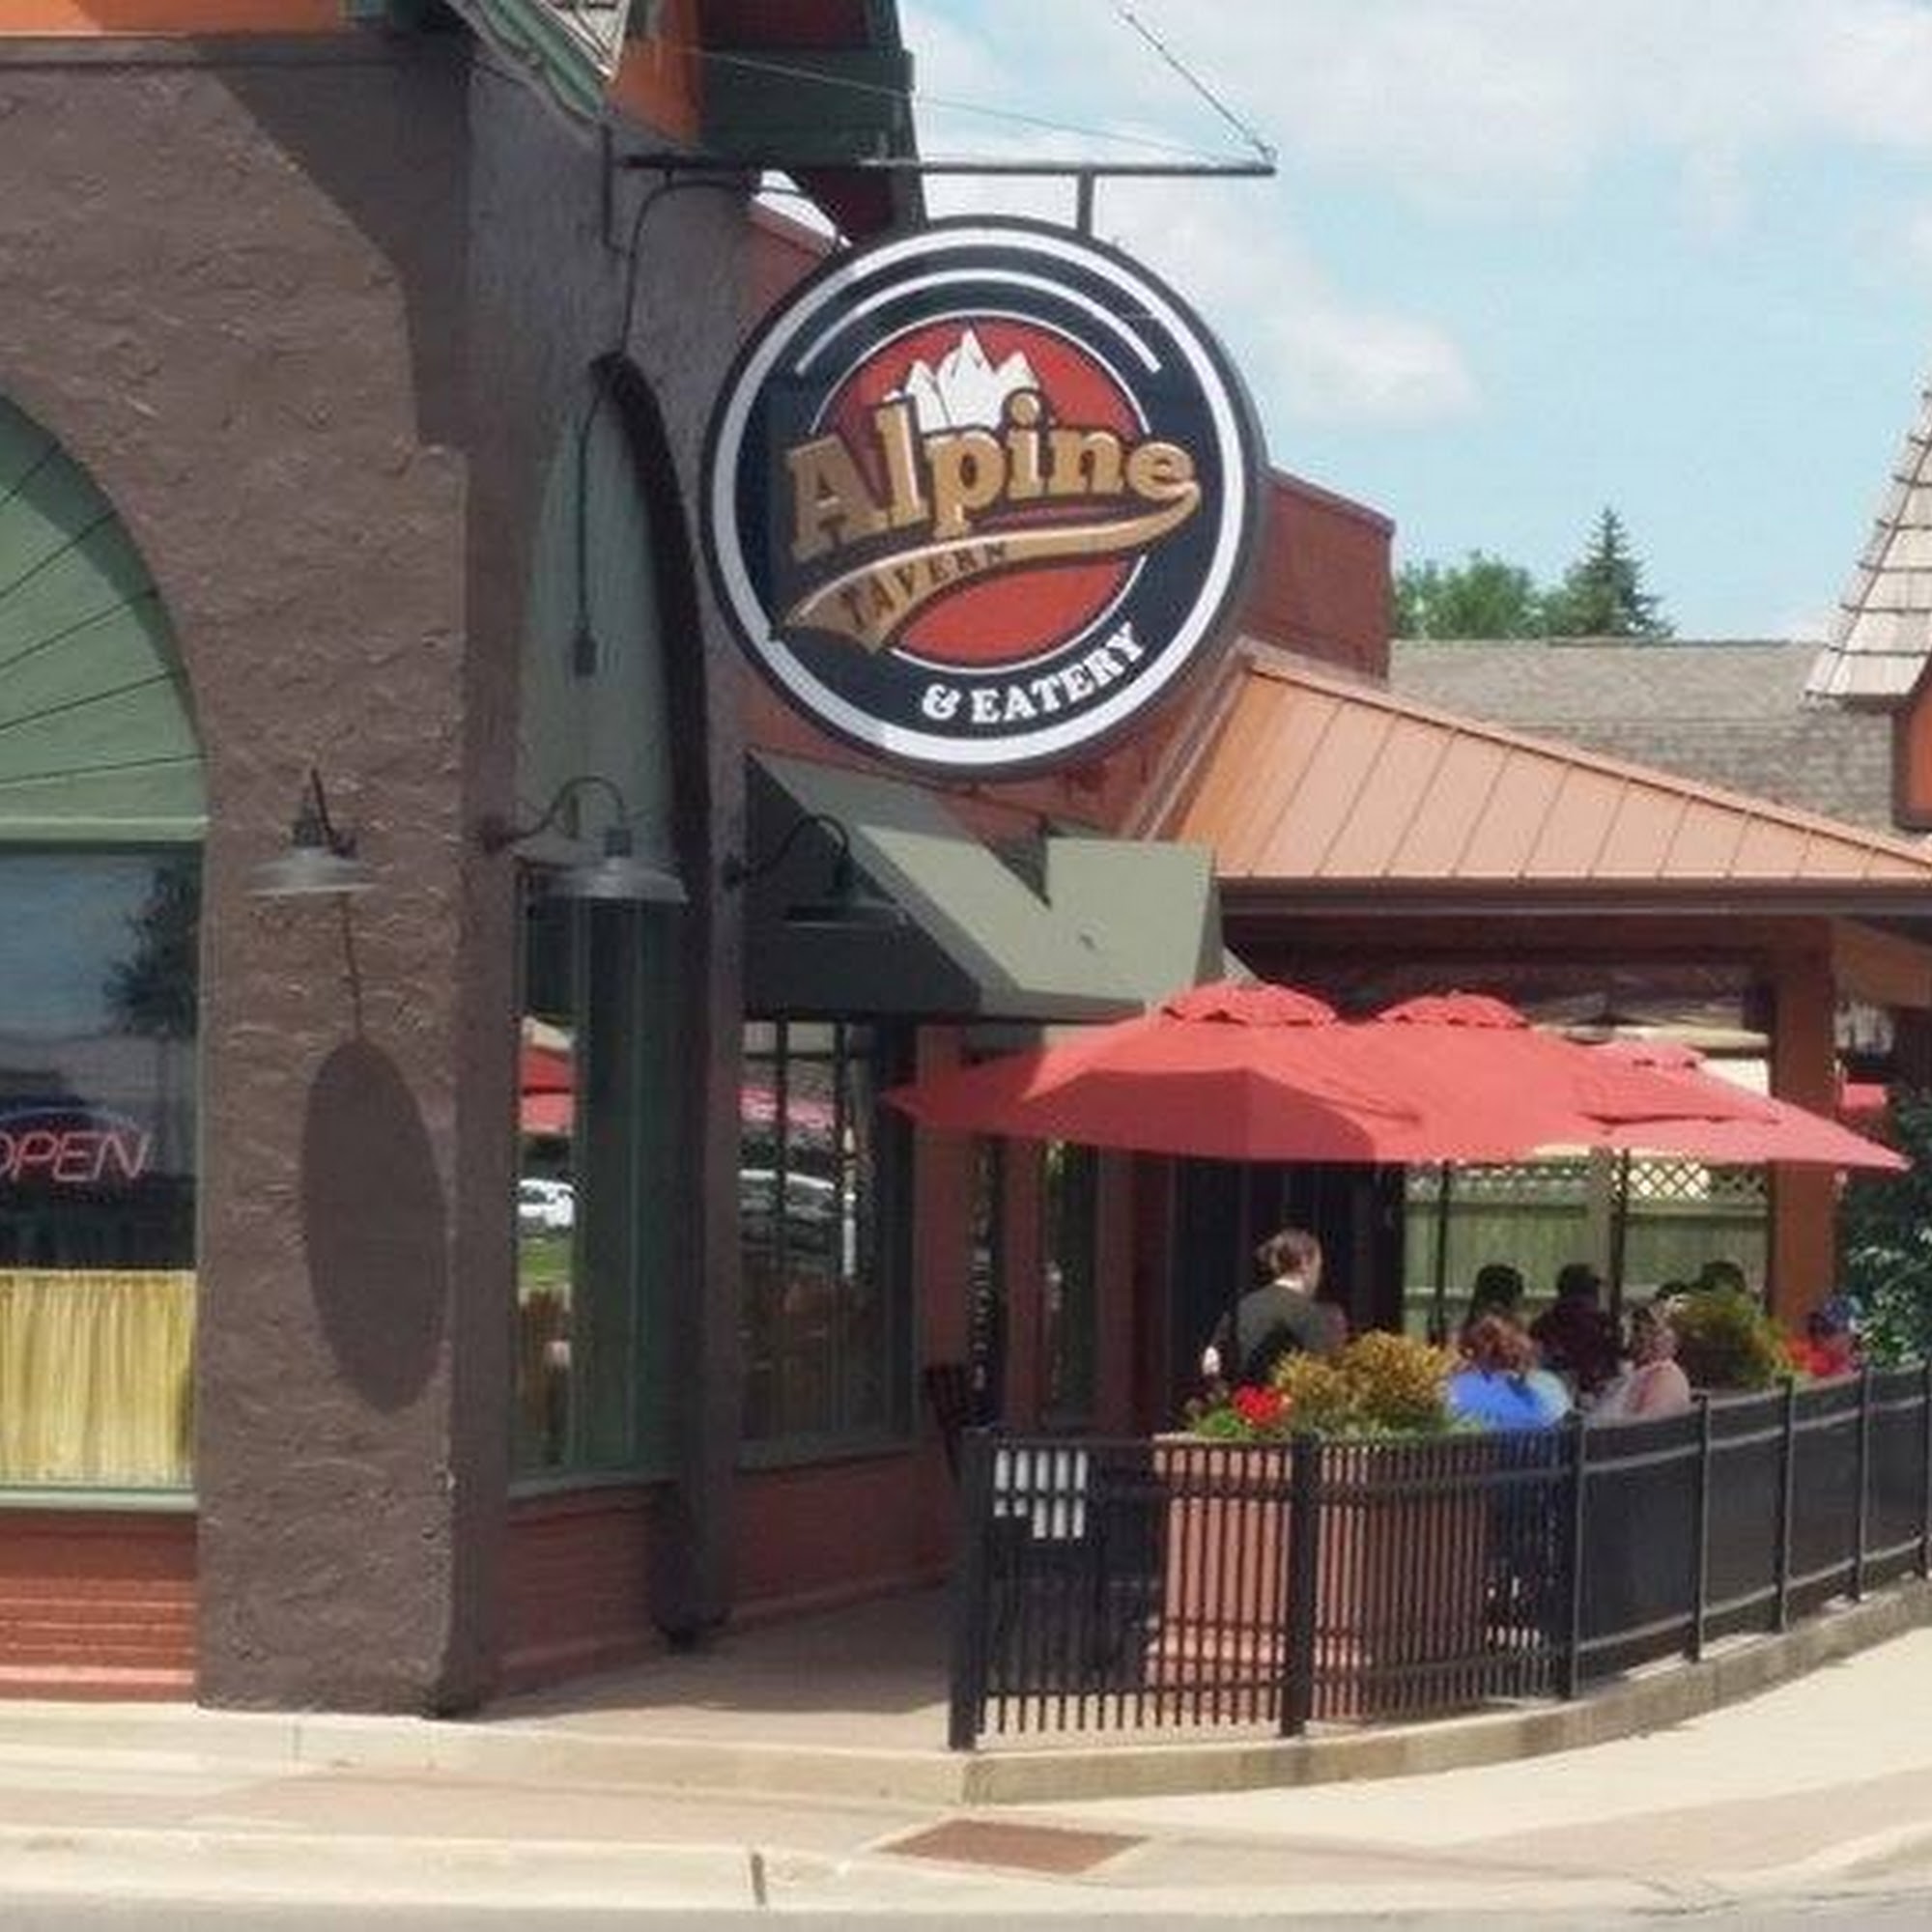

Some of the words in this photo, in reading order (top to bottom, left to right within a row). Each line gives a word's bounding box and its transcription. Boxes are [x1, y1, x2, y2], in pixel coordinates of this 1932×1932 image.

[784, 391, 1200, 562] Alpine
[838, 542, 1008, 631] TAVERN
[922, 684, 961, 721] &
[970, 620, 1144, 724] EATERY
